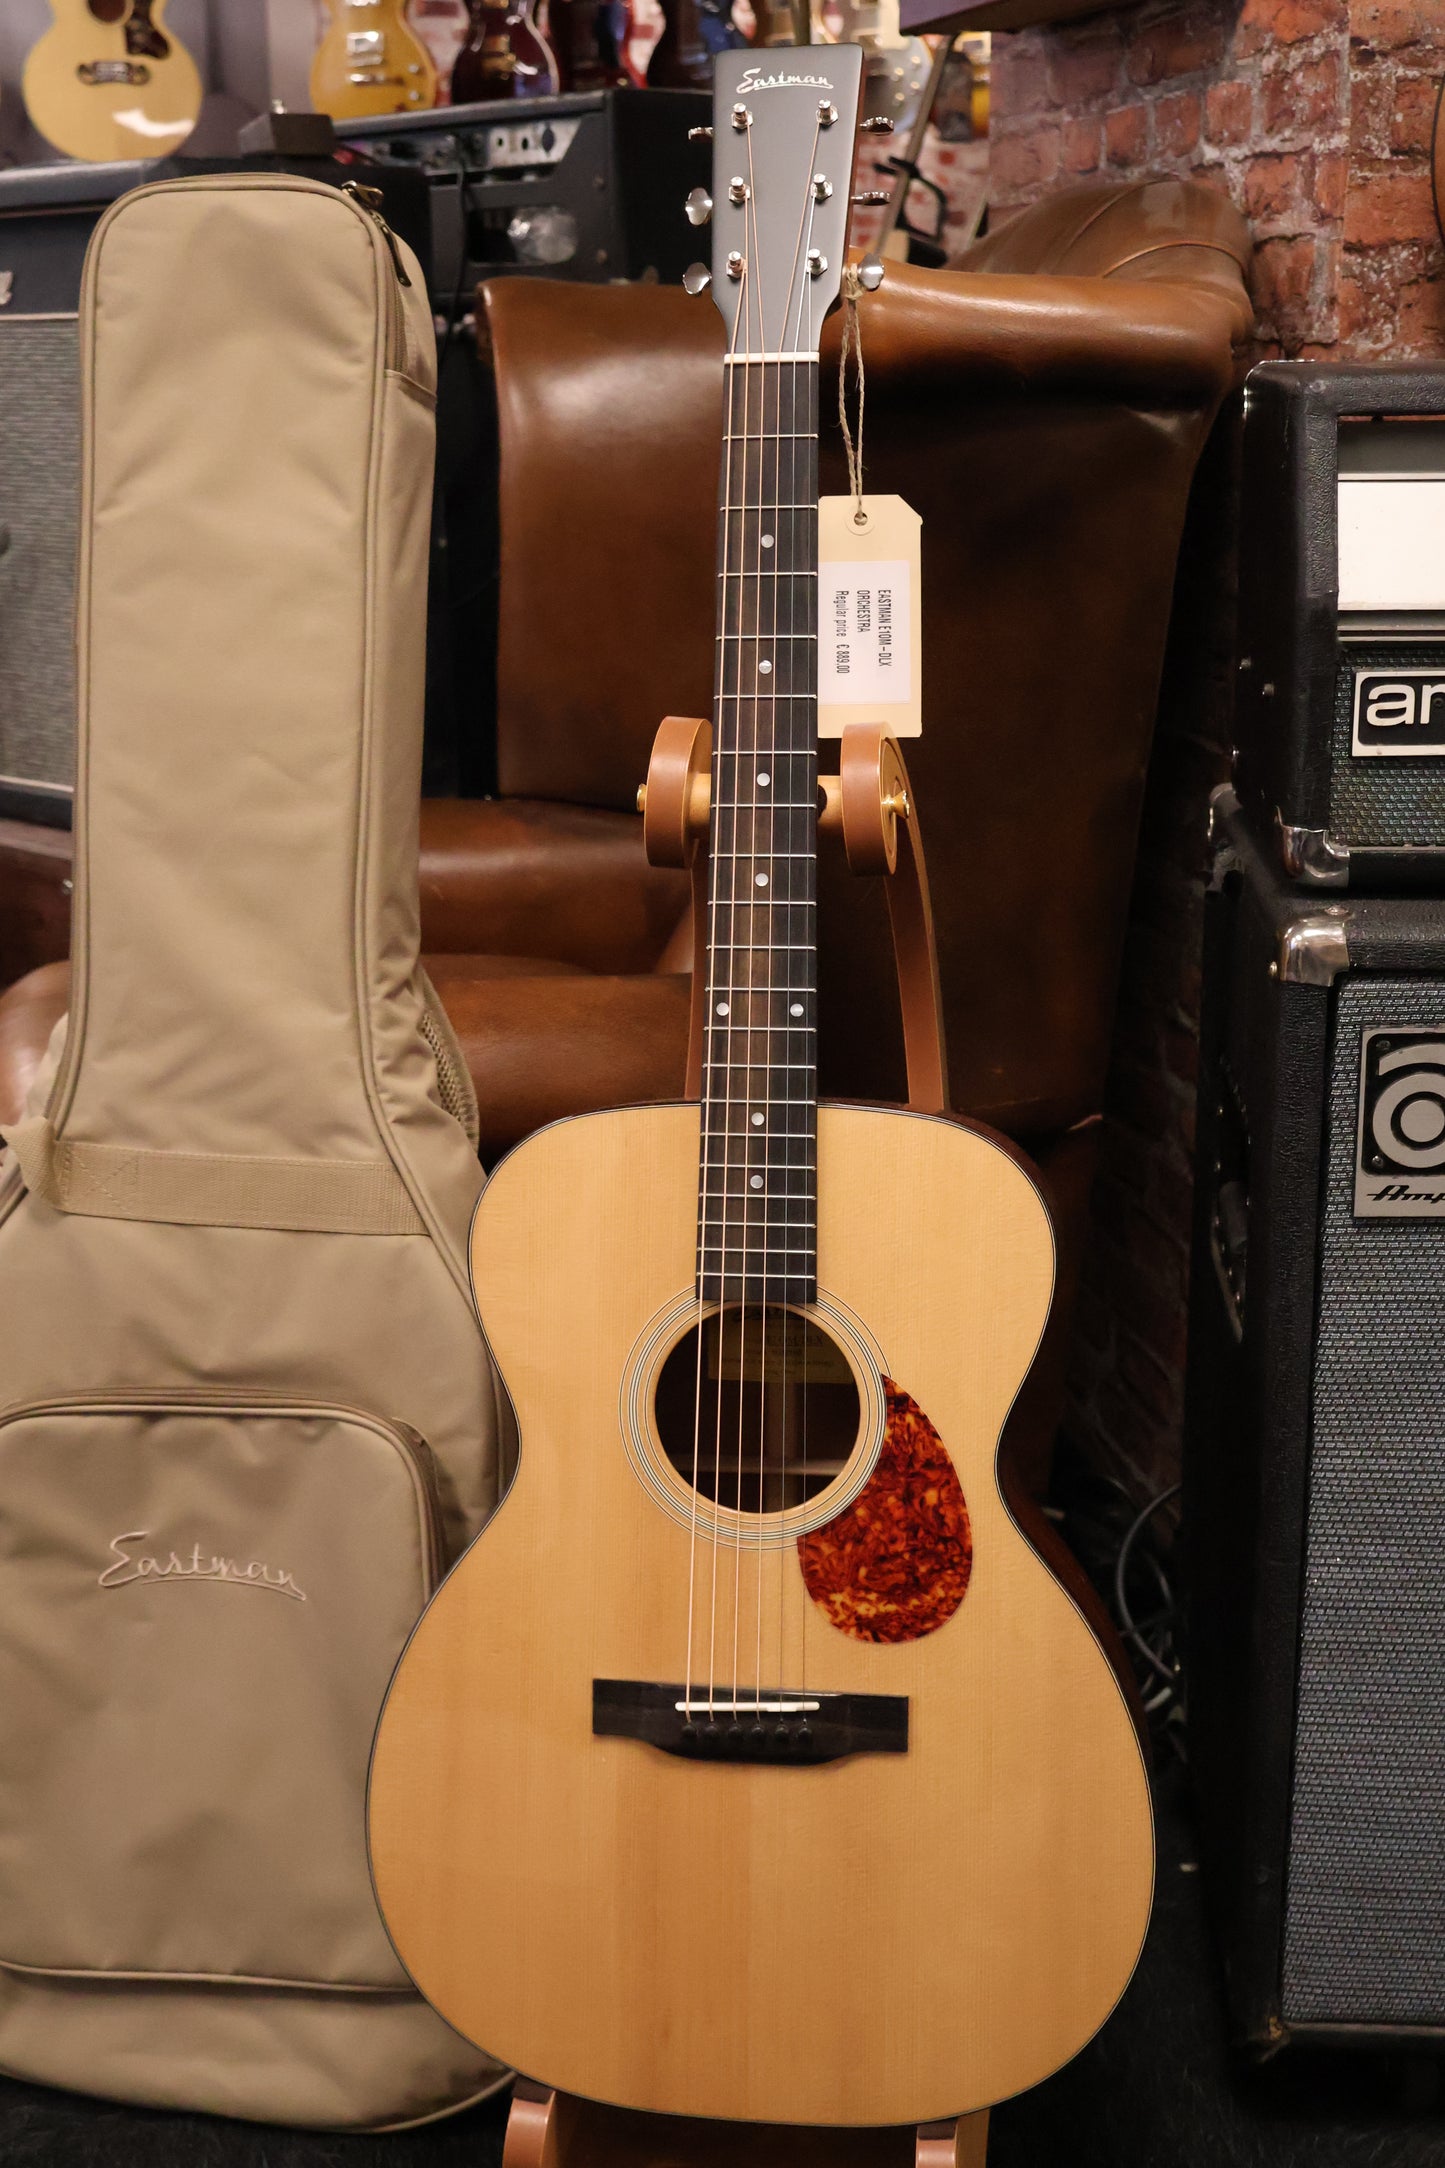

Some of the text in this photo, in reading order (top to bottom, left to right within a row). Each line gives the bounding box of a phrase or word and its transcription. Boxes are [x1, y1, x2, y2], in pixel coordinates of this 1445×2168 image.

[736, 67, 834, 94] Eastman
[833, 590, 849, 617] Regular
[857, 589, 871, 633] ORCHESTRA
[877, 589, 892, 623] EASTMAN
[834, 619, 849, 637] price
[837, 650, 850, 674] 889.00
[98, 1530, 306, 1600] Eastman
